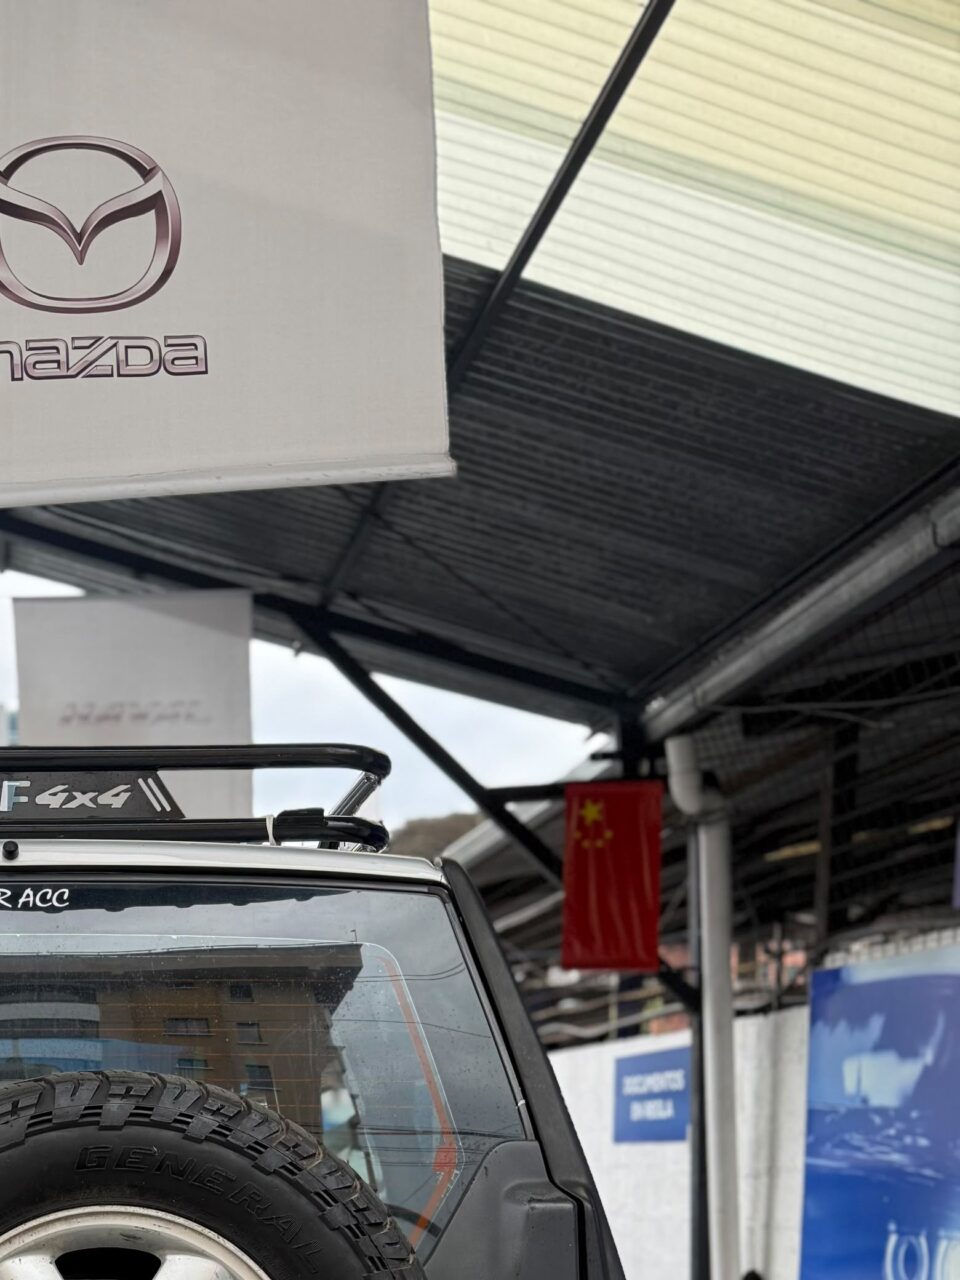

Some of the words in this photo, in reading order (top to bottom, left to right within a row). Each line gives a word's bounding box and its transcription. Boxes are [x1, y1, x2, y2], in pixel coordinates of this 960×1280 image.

[34, 783, 134, 810] 4x4
[17, 888, 70, 908] ACC
[73, 1144, 323, 1275] GENERAL
